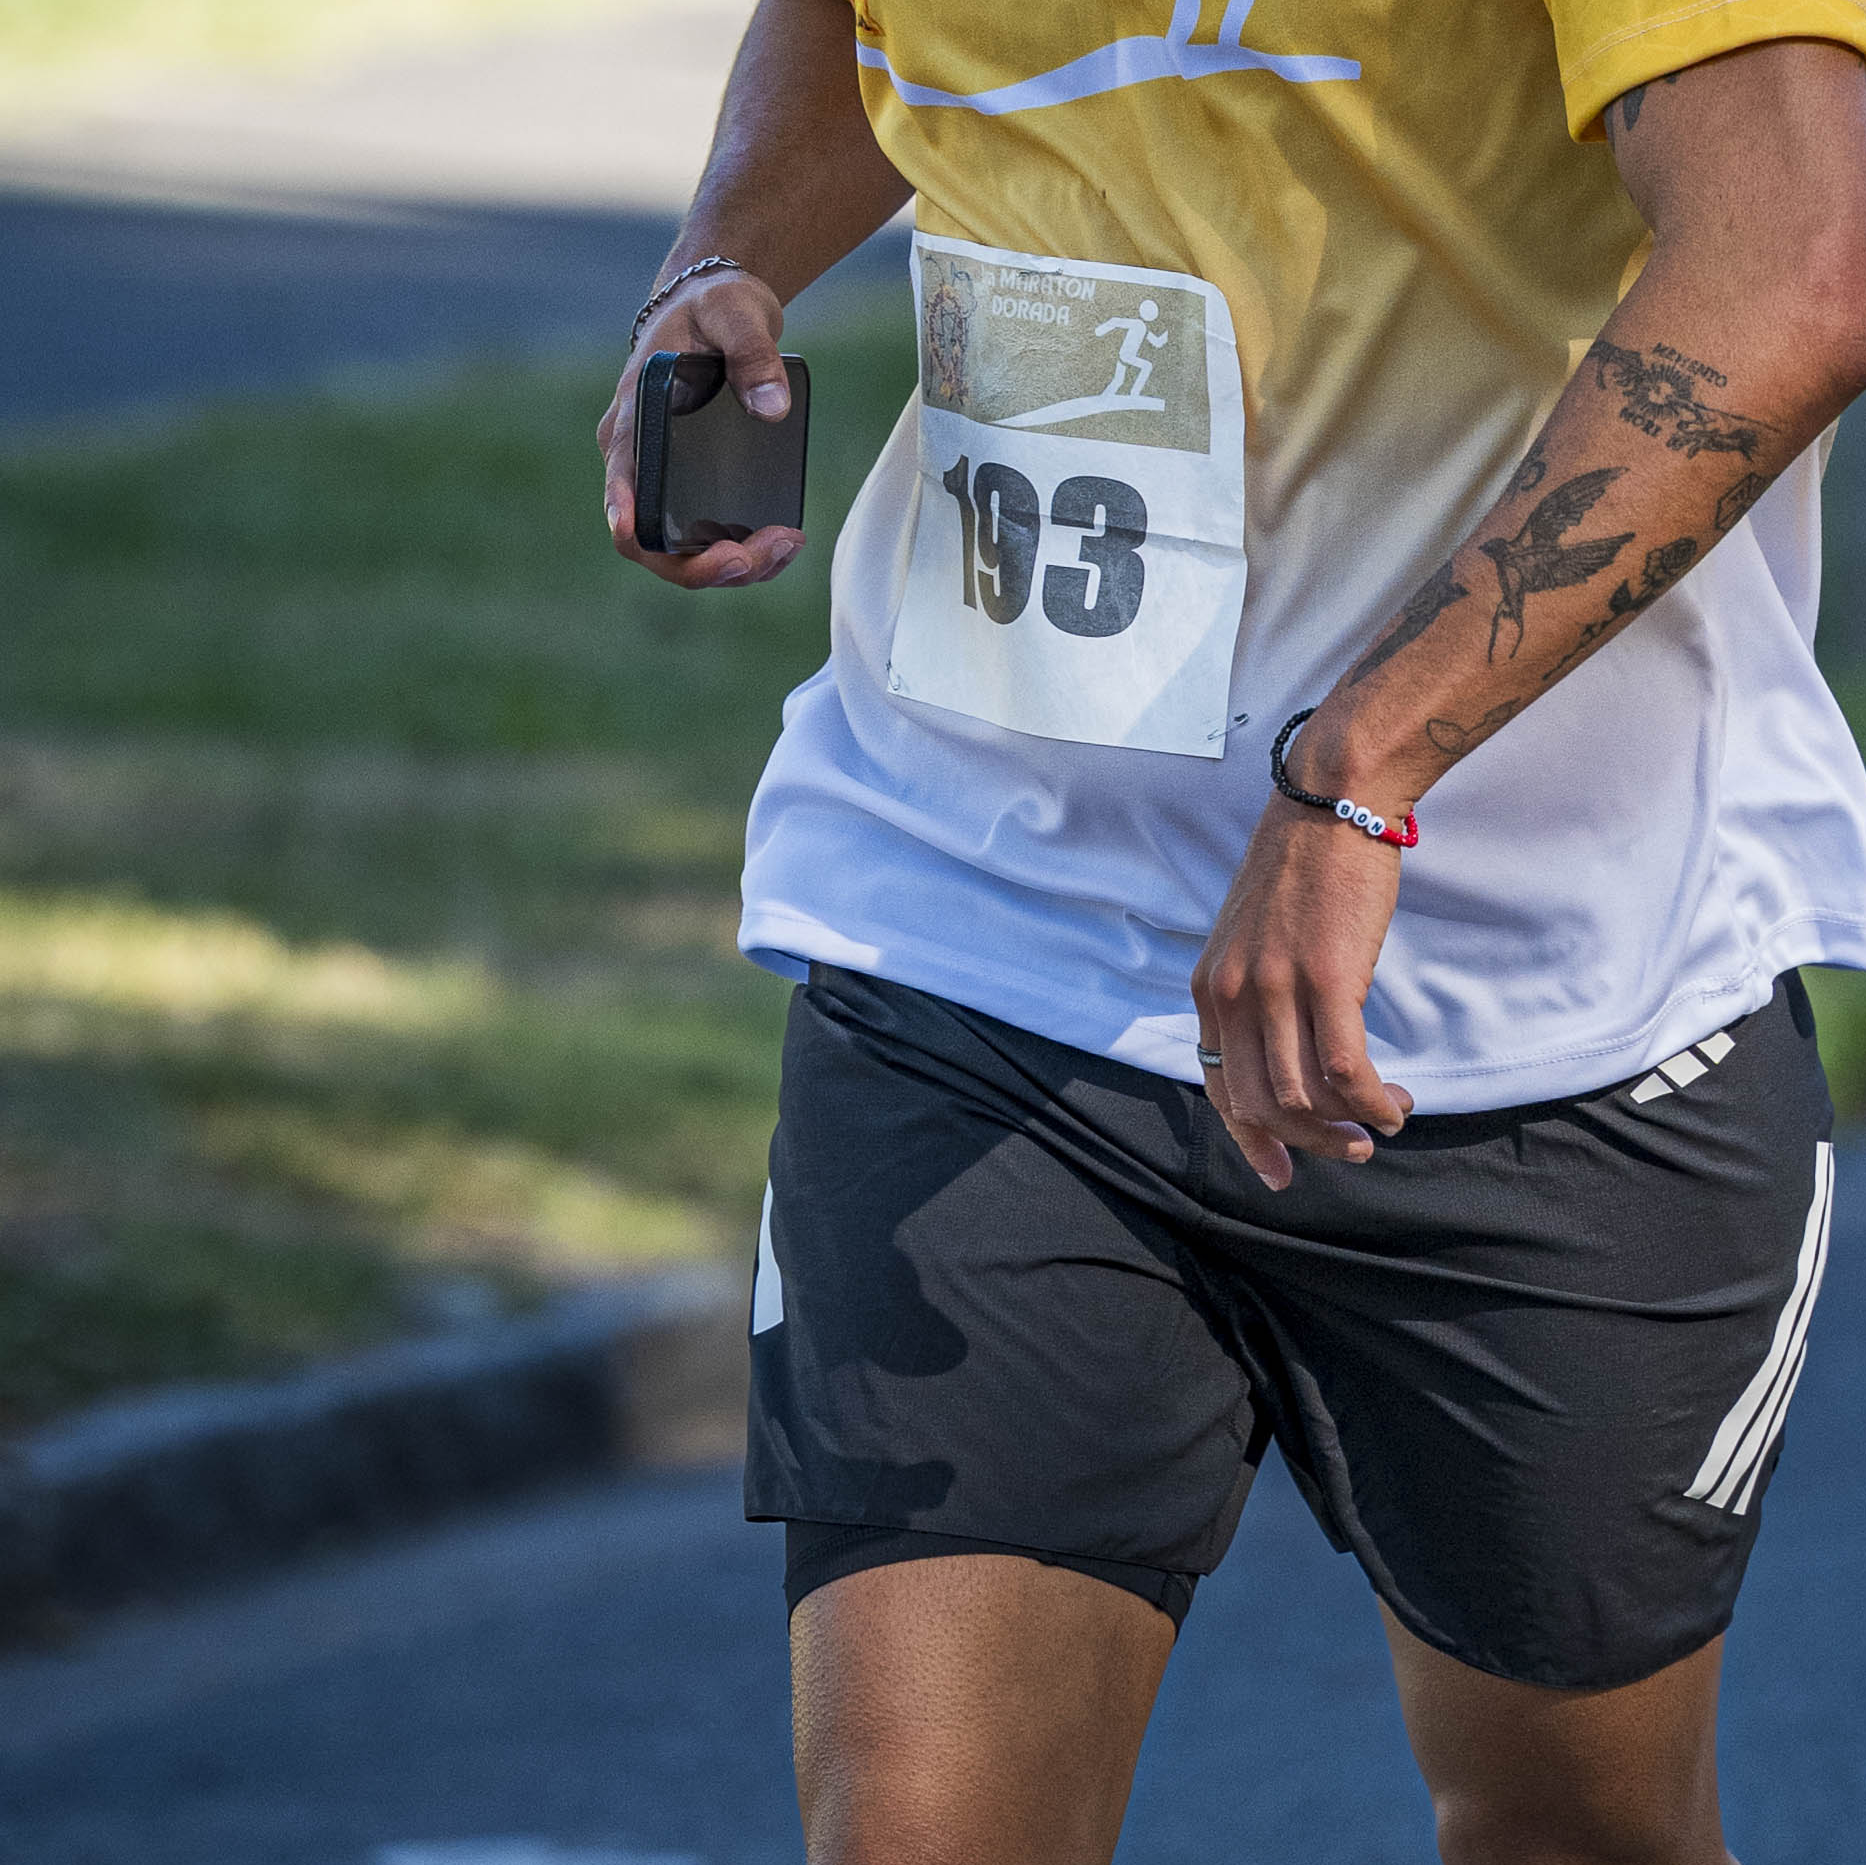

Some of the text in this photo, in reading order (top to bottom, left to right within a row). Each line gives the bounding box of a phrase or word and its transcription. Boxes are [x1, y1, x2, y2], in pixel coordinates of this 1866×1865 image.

[991, 294, 1072, 327] DORADA
[942, 453, 1148, 638] 193
[1339, 803, 1384, 835] BON
